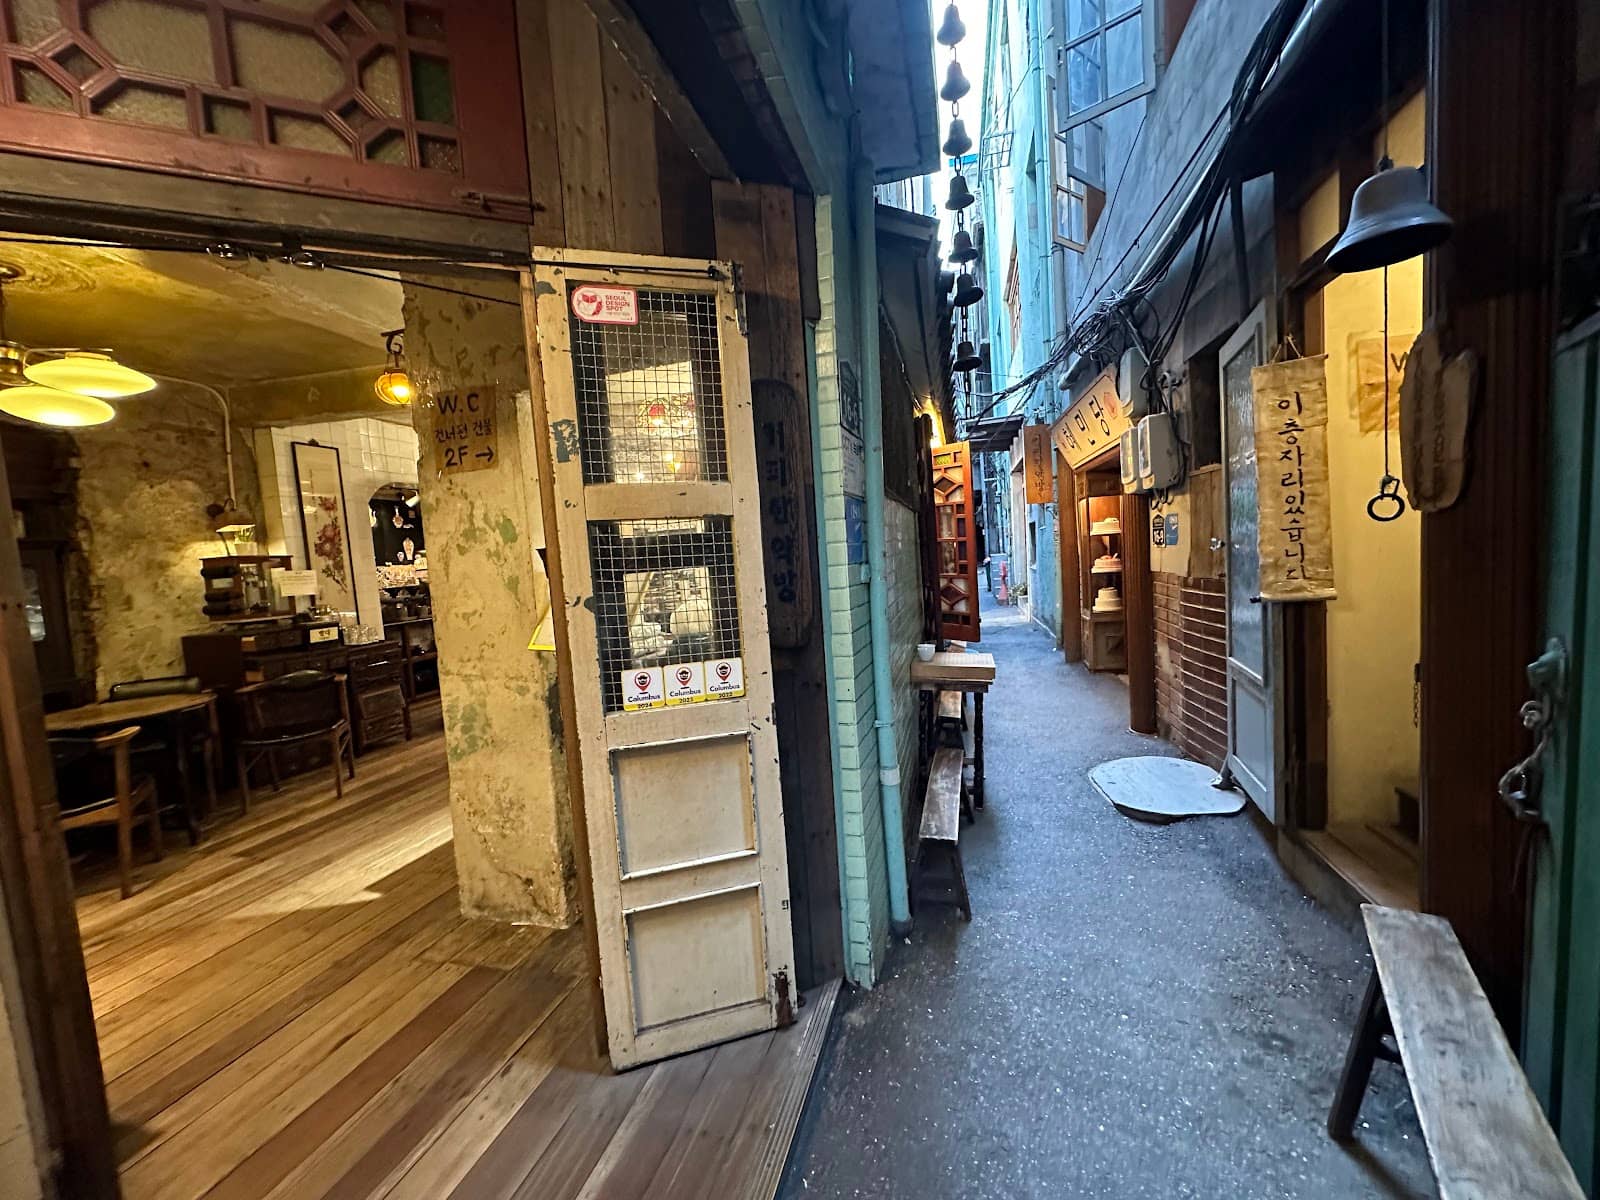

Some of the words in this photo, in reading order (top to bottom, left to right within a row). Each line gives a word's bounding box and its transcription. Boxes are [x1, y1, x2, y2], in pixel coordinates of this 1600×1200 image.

[436, 393, 479, 414] W.C
[445, 445, 468, 467] 2F
[669, 688, 701, 698] Columbus
[709, 684, 740, 692] Columbus
[627, 693, 661, 703] Columbus
